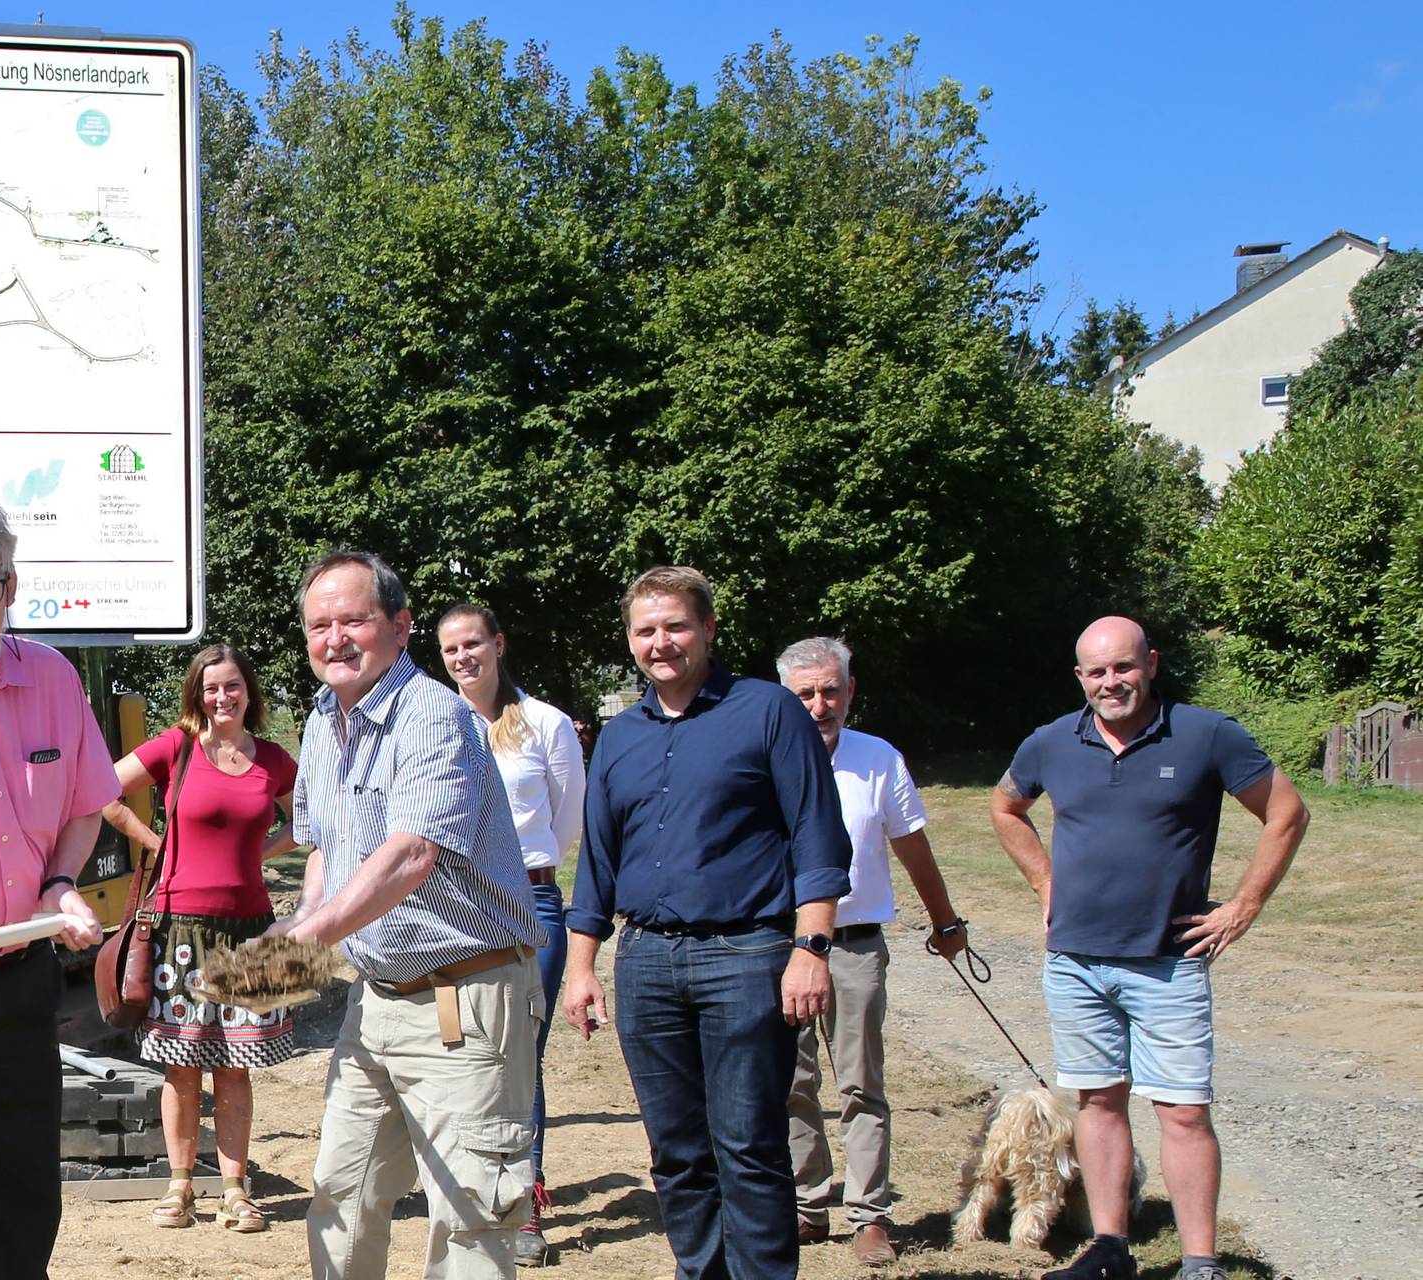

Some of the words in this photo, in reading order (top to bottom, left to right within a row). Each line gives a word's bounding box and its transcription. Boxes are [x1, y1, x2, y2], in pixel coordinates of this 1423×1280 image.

[33, 62, 150, 88] Nösnerlandpark
[126, 577, 167, 591] Union
[97, 854, 116, 878] 314E
